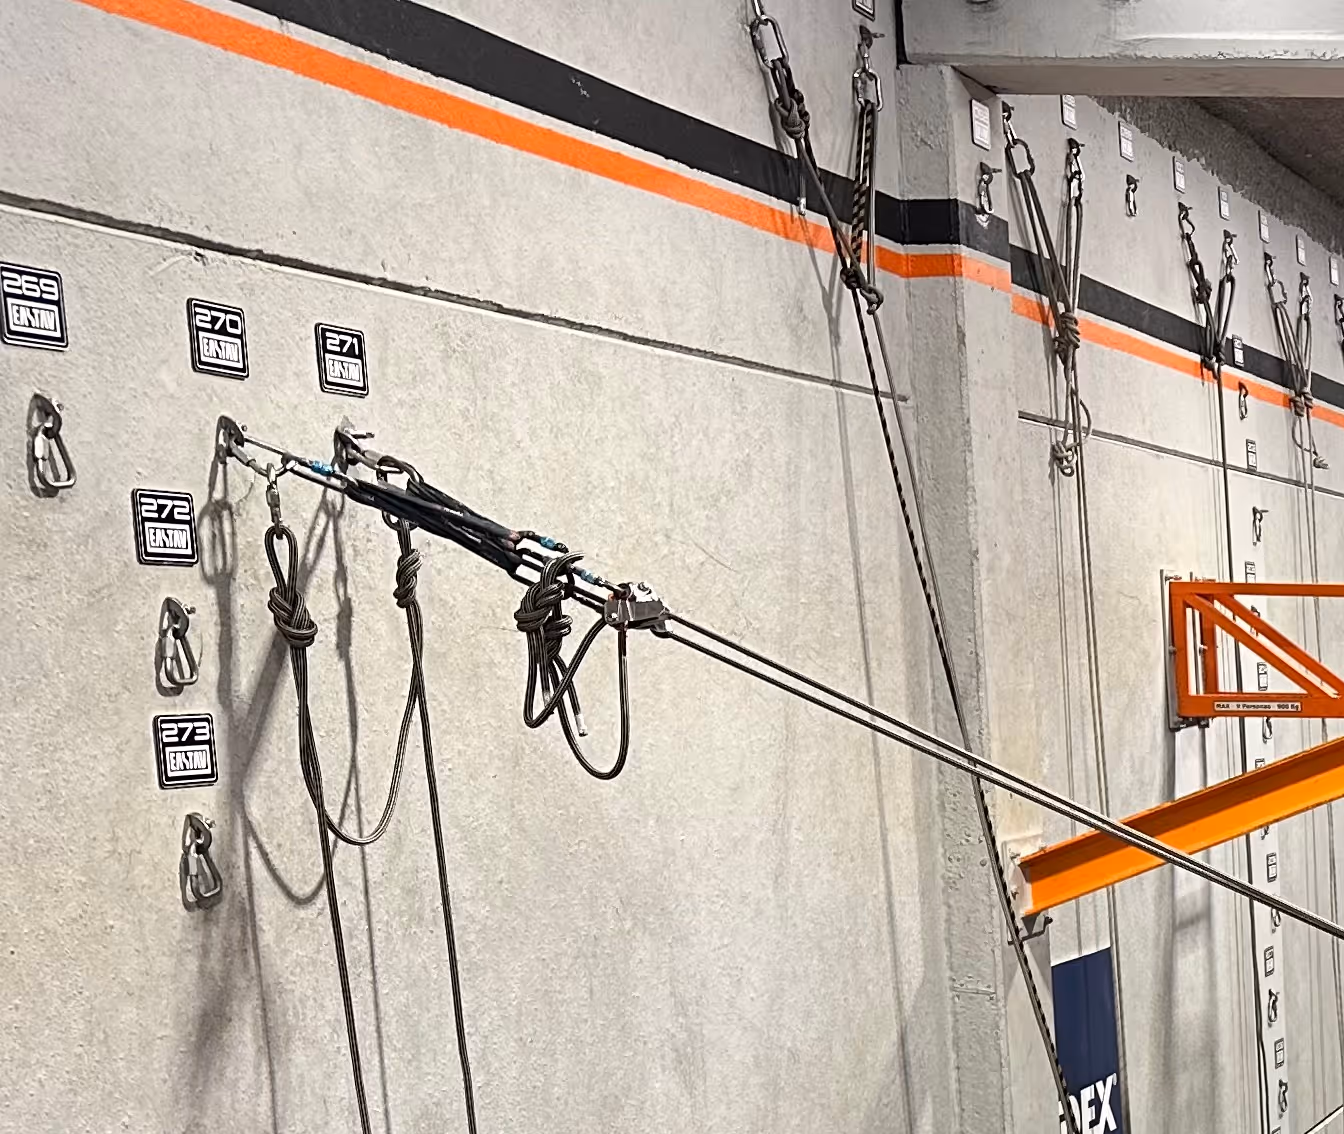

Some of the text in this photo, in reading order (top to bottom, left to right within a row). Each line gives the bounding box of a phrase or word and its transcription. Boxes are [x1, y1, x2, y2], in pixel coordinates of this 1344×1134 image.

[1, 271, 60, 301] 269
[12, 305, 55, 331] EASTAV
[194, 307, 242, 335] 270
[325, 331, 358, 356] 271
[140, 497, 190, 520] 272
[149, 528, 187, 549] EASTAV
[161, 722, 210, 742] 273
[169, 751, 207, 771] EASTAV
